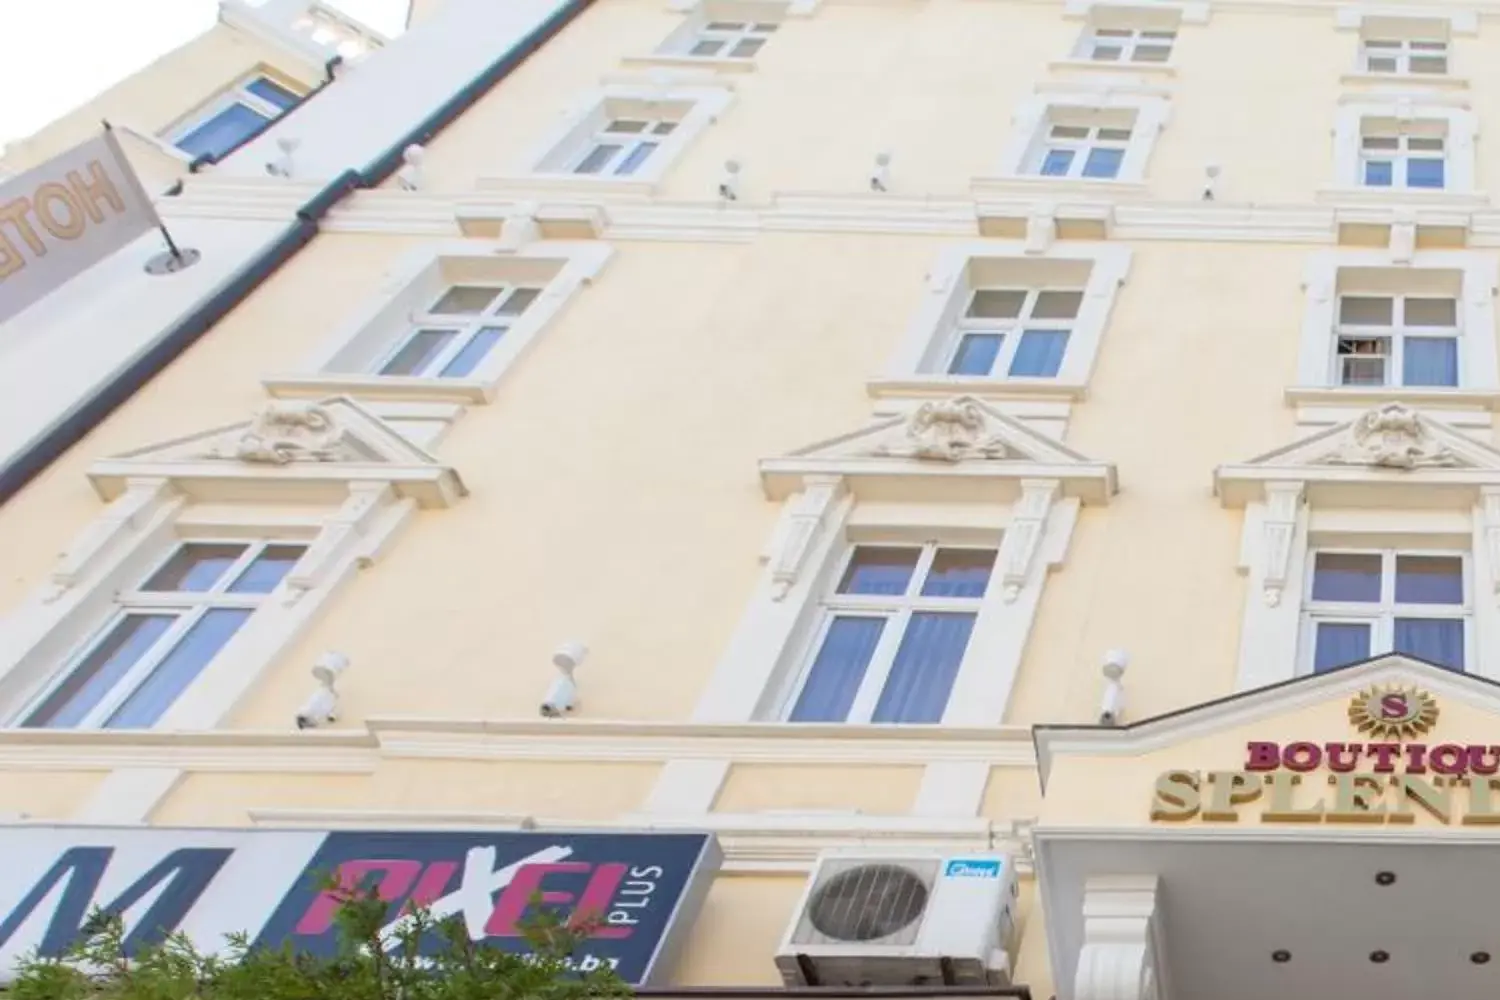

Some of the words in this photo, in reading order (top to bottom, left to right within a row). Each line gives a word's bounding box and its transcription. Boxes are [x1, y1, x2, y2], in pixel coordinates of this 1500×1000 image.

[1381, 693, 1409, 719] S
[296, 845, 638, 948] PIXEL
[607, 865, 663, 925] PLUS
